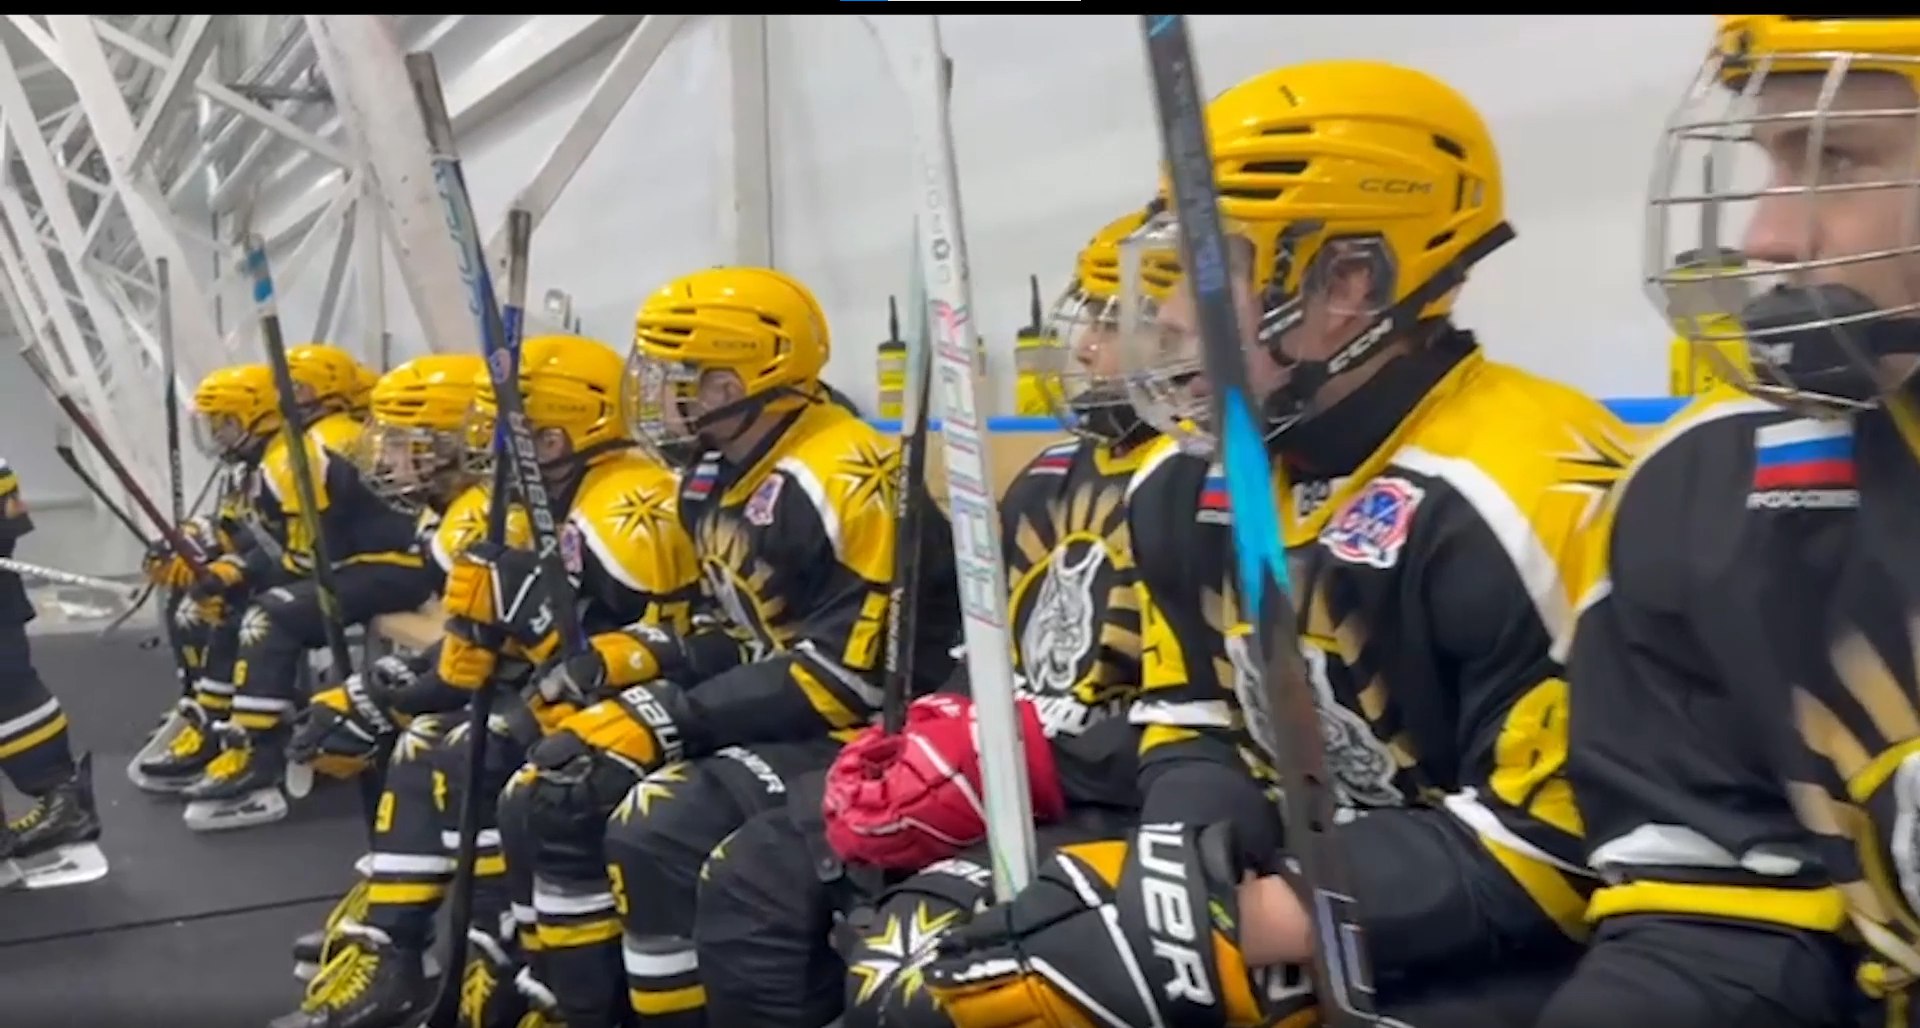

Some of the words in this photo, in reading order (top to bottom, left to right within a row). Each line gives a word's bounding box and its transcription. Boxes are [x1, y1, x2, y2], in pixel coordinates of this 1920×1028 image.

[1357, 178, 1434, 194] CCM
[1328, 317, 1394, 374] CCM
[1136, 821, 1216, 1007] UER
